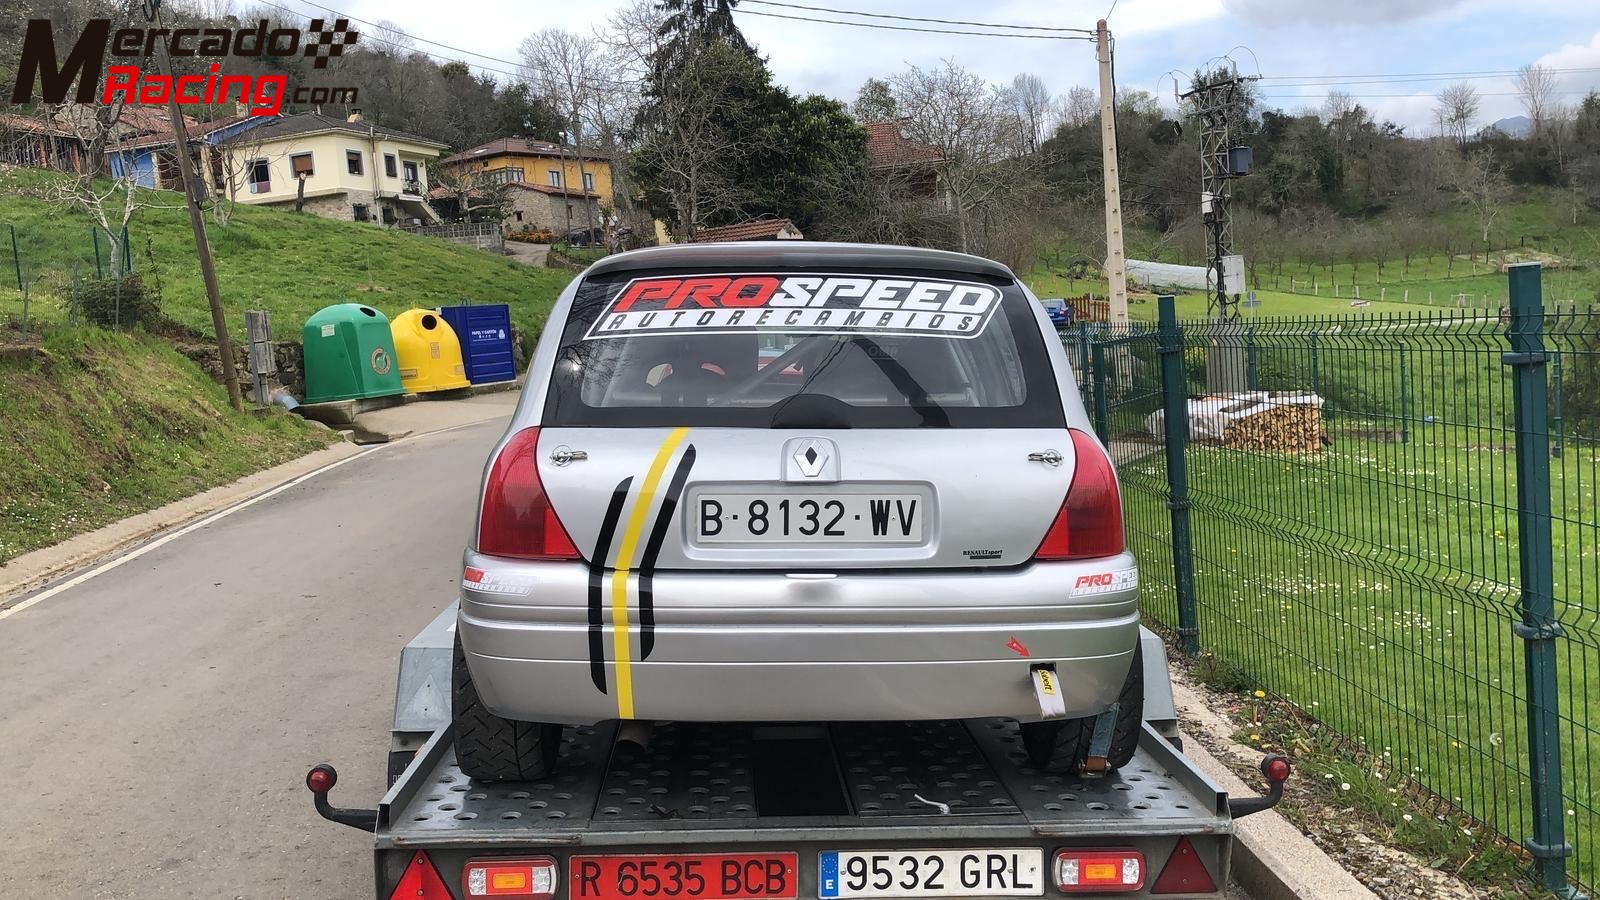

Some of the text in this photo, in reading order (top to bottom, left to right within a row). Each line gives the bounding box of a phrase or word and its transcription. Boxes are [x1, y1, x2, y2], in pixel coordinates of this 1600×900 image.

[613, 277, 995, 313] PROSPEED
[607, 309, 973, 331] AUTORECAMBIOS
[580, 859, 786, 897] R 6535 BCB
[825, 879, 834, 890] E
[846, 853, 1034, 891] 9532 GRL
